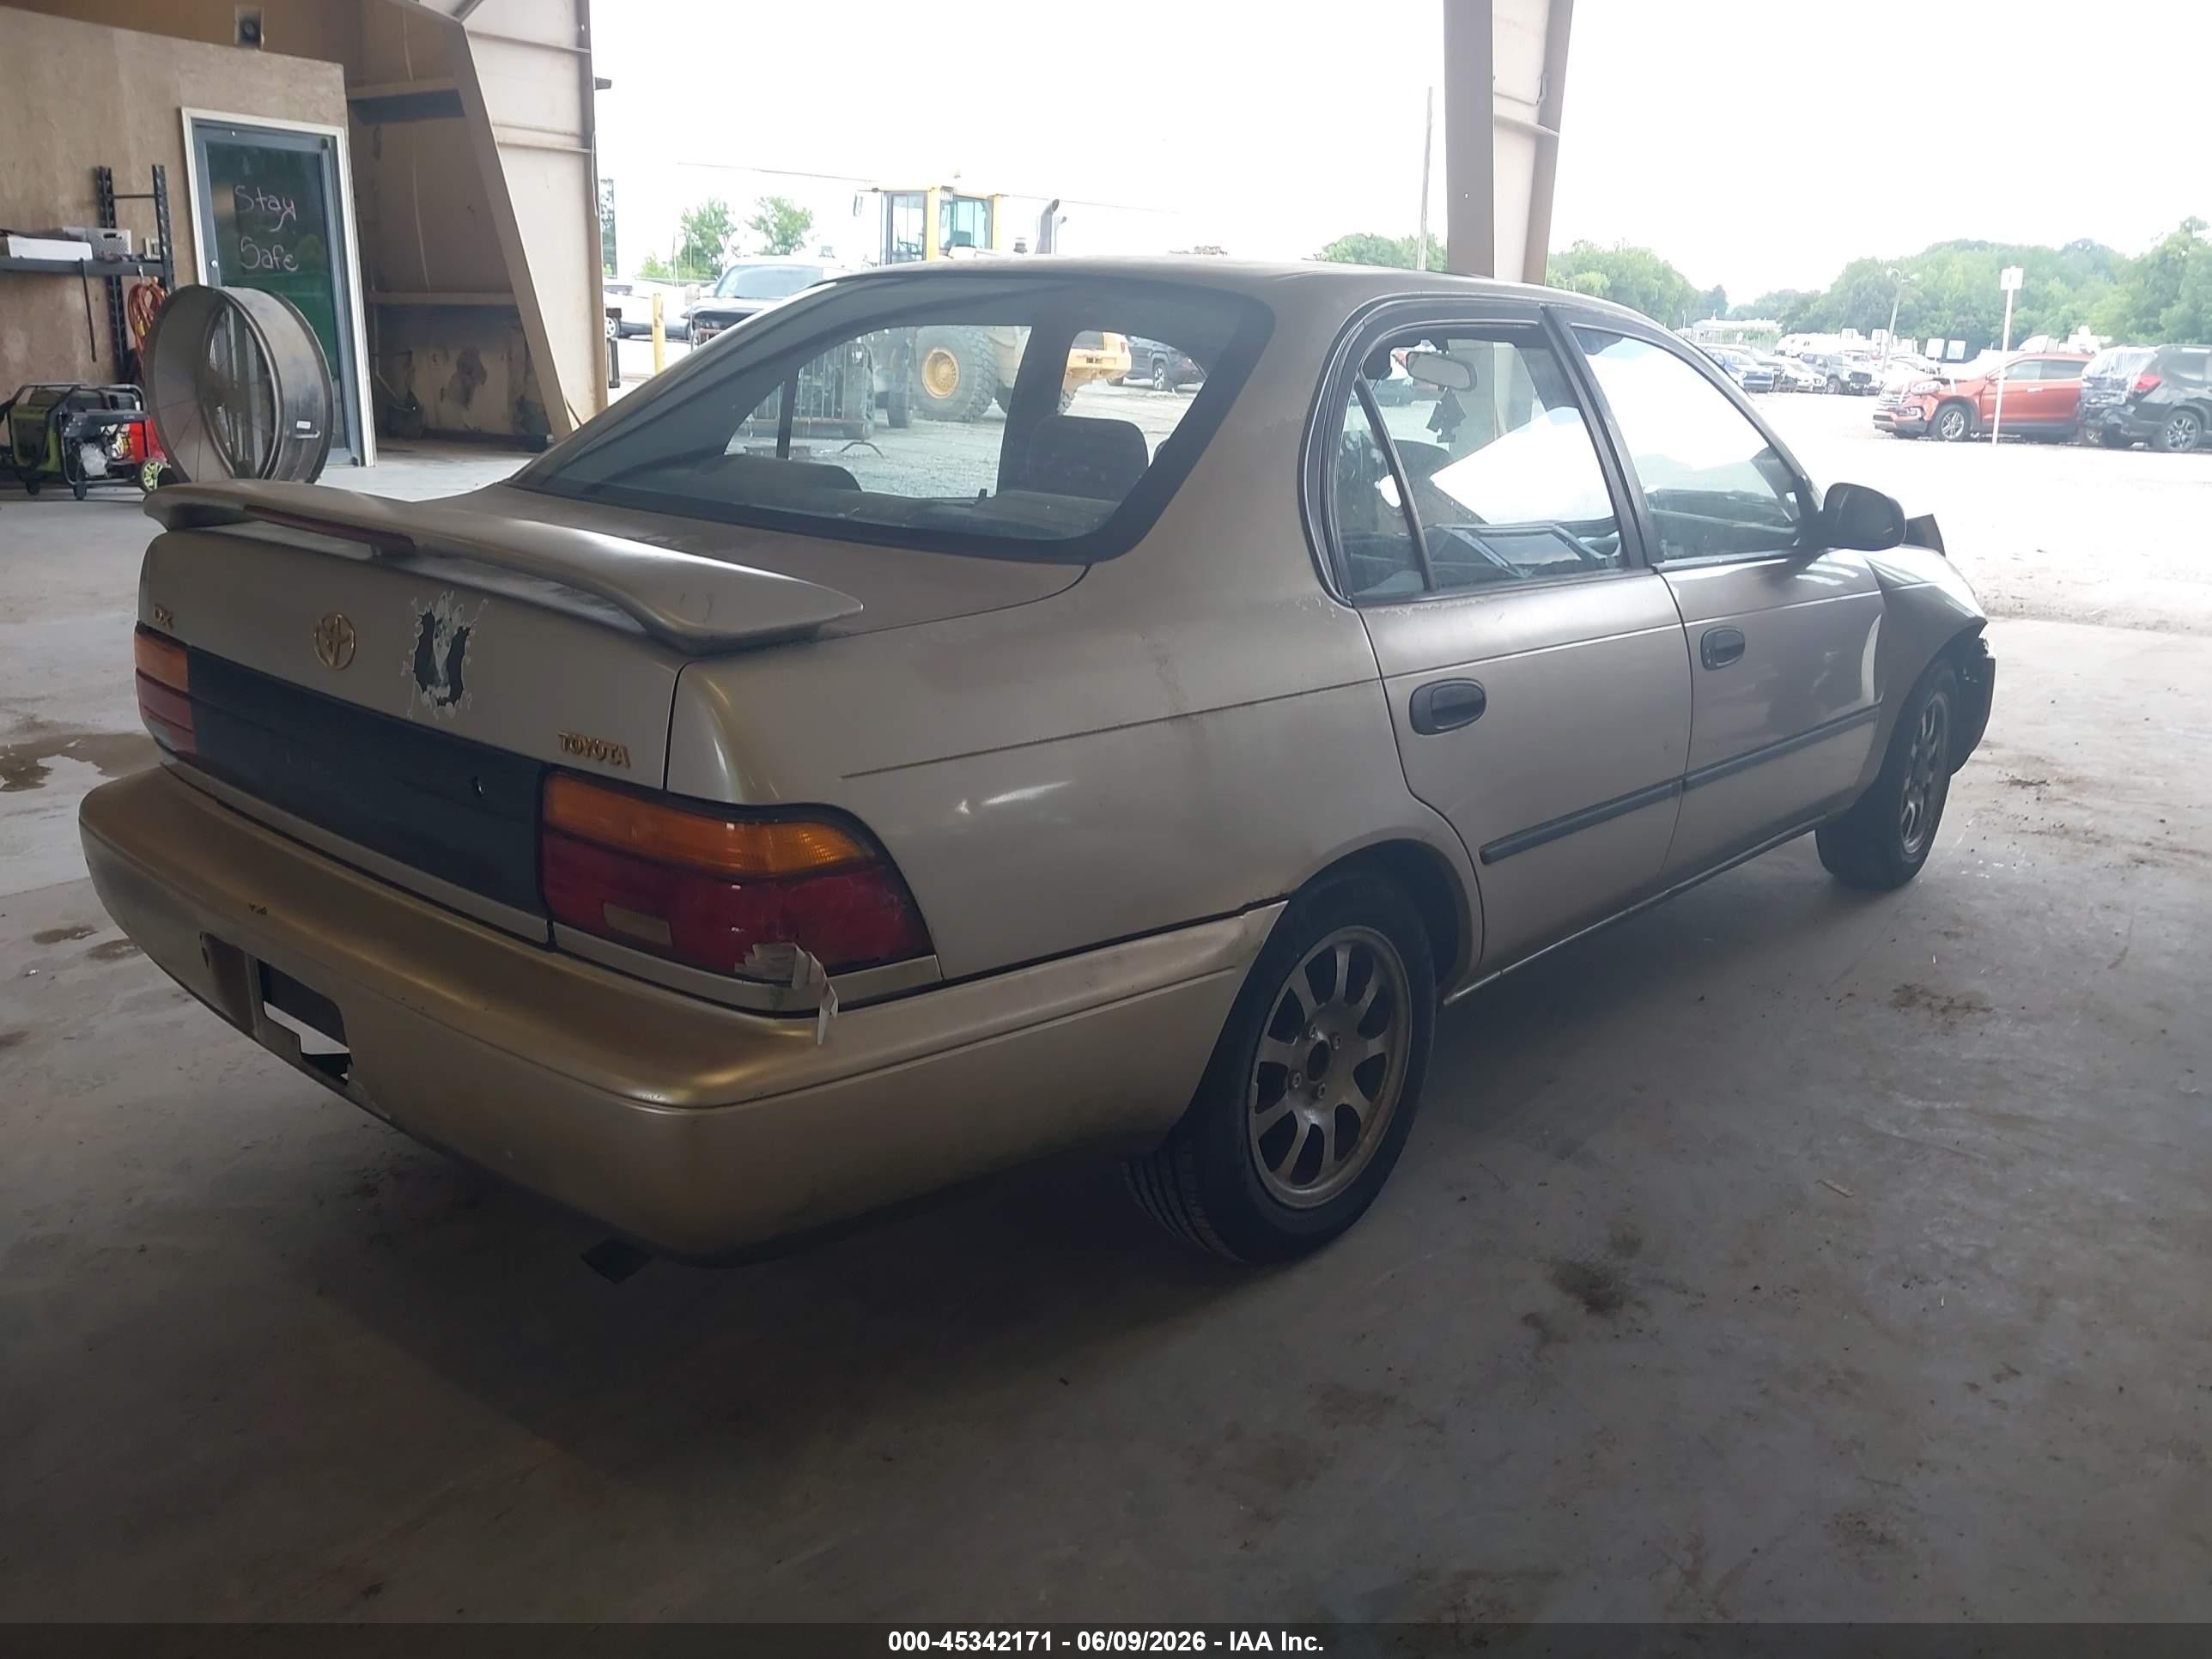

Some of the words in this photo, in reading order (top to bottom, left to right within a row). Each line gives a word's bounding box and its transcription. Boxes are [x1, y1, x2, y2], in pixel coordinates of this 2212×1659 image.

[234, 185, 296, 233] Stay
[240, 236, 299, 271] Safe
[557, 731, 631, 769] TOYOTA
